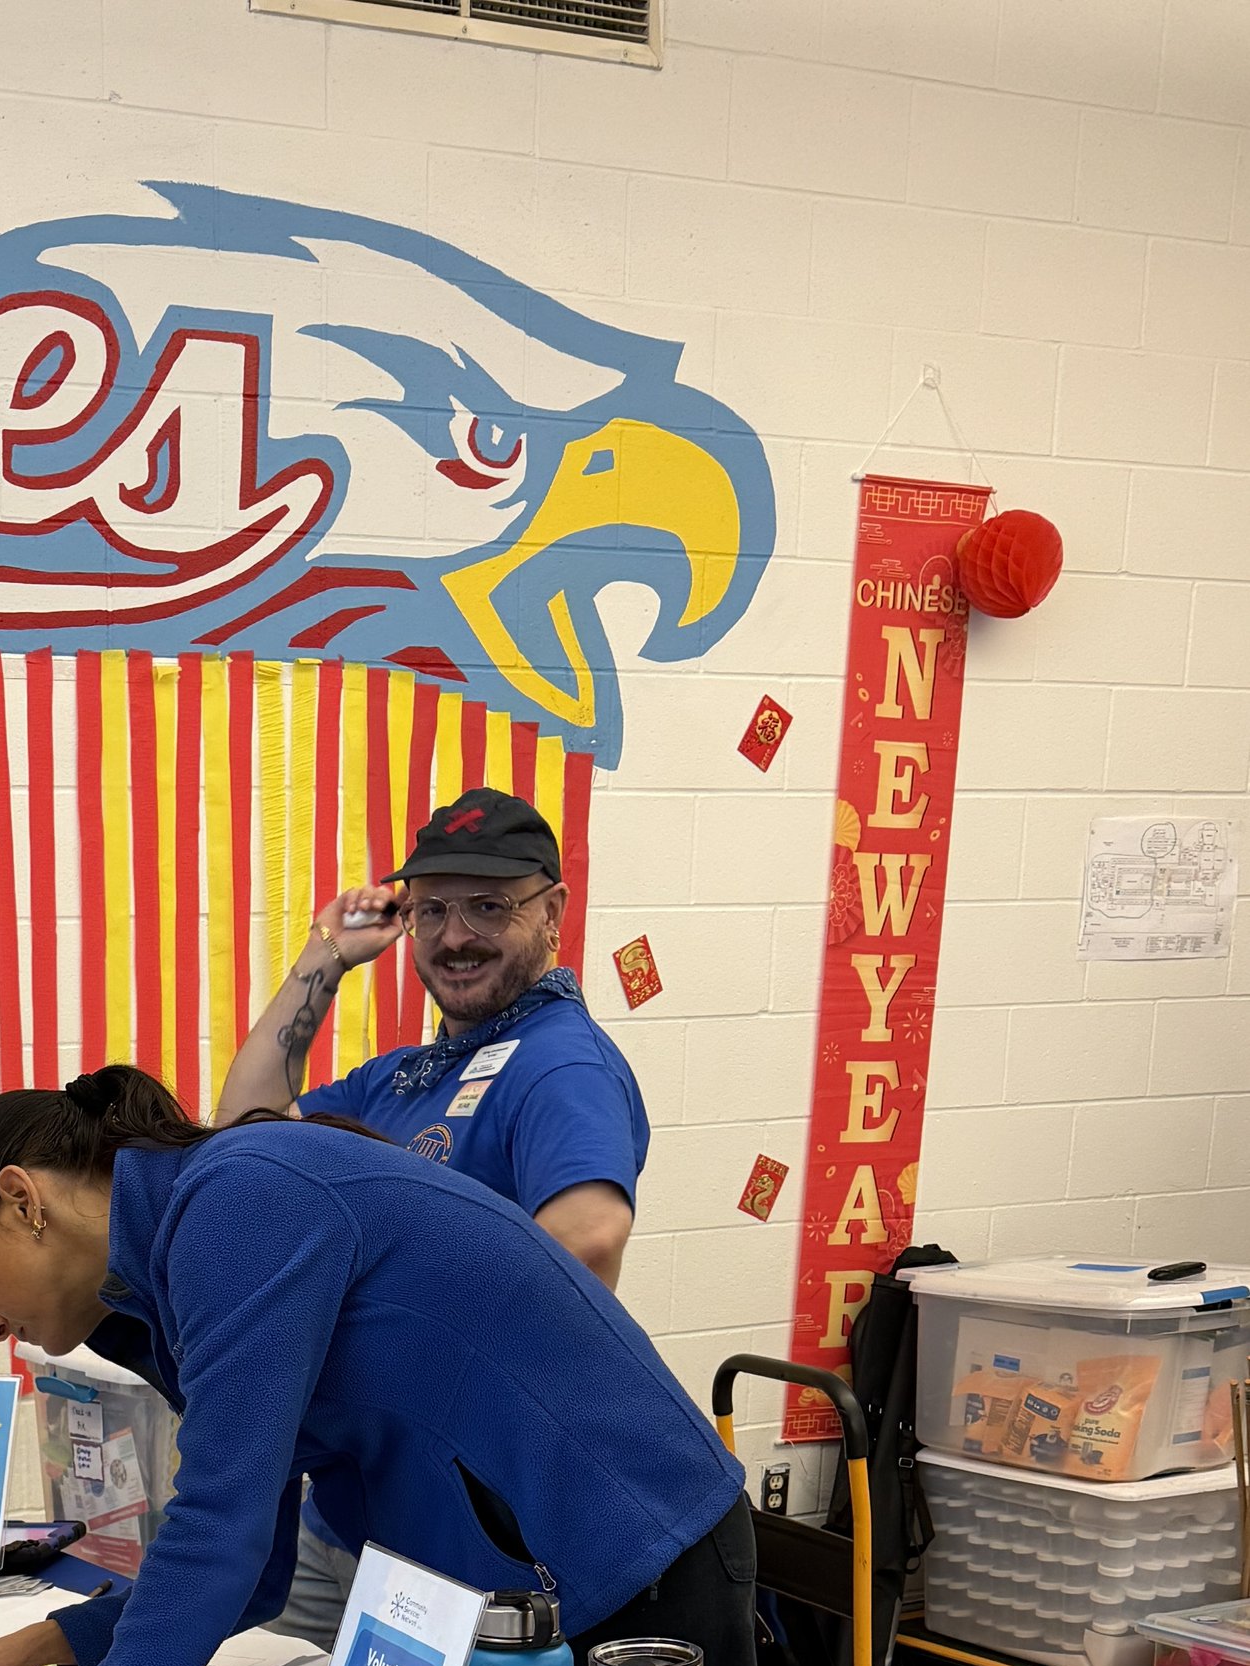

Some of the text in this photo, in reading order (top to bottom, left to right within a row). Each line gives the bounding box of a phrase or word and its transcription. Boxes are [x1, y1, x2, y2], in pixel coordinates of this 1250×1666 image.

[856, 577, 969, 615] CHINESE
[1082, 1418, 1099, 1426] pure
[1094, 1426, 1121, 1438] Soda
